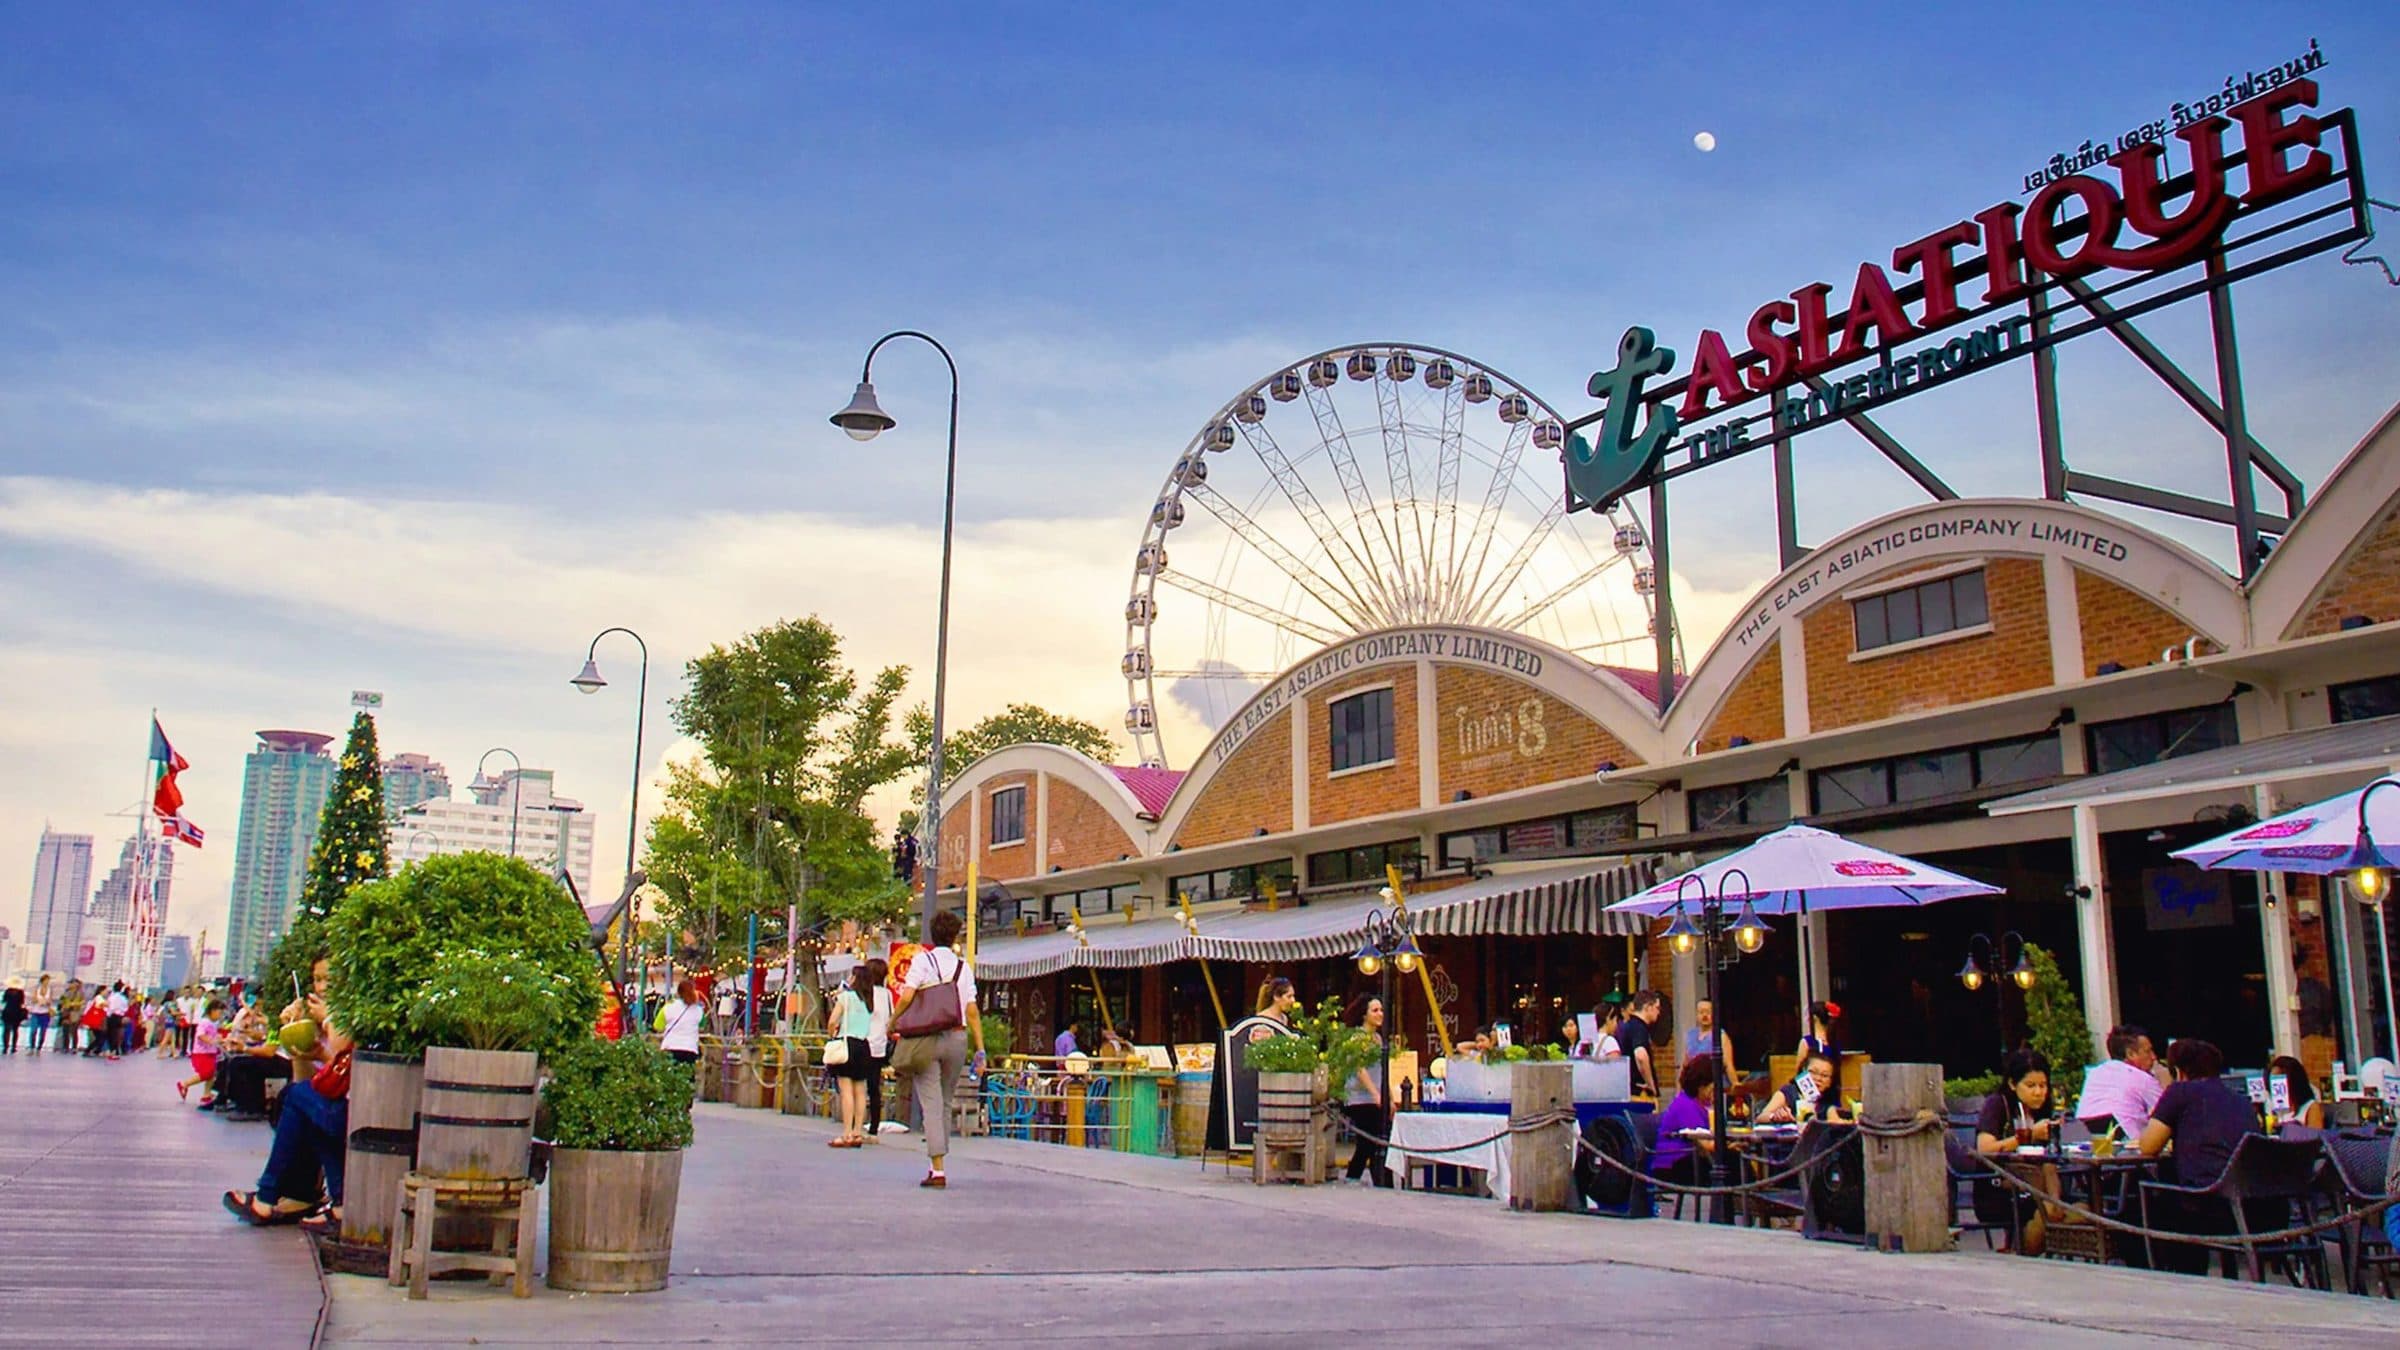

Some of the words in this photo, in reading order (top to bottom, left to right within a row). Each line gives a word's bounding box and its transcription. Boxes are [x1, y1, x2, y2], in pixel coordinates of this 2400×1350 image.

[1677, 77, 2333, 419] ASIATIQUE
[1684, 417, 1750, 464] THE
[1779, 314, 2027, 429] RIVERFRONT
[1736, 609, 1772, 647] THE
[1774, 570, 1820, 612] EAST
[1827, 530, 1906, 580] ASIATIC
[1909, 519, 2022, 543] COMPANY
[2030, 521, 2128, 563] LIMITED
[1212, 728, 1243, 763] THE
[1244, 695, 1285, 731] EAST
[1286, 650, 1351, 698] ASIATIC
[1354, 633, 1448, 664] COMPANY
[1452, 635, 1543, 678] LIMITED
[1518, 699, 1546, 757] 8
